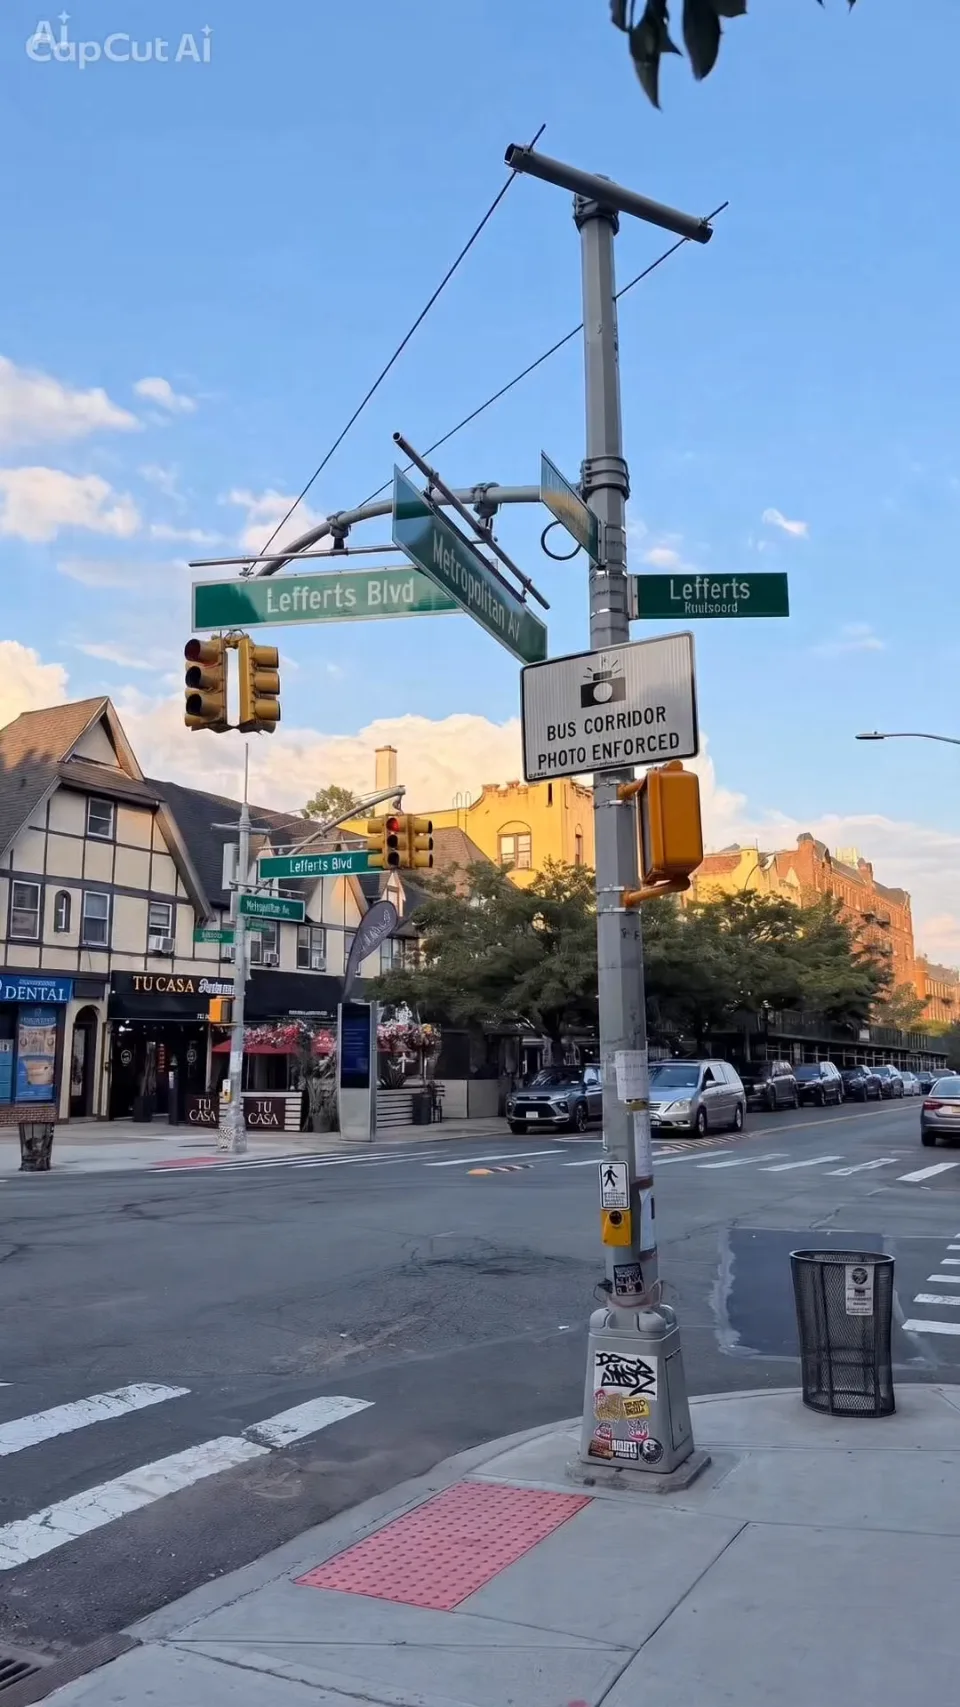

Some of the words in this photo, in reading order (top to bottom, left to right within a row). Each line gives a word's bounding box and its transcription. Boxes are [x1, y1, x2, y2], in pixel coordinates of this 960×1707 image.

[433, 529, 505, 631] Metropolitan
[670, 575, 751, 600] Lefferts
[267, 582, 357, 614] Lefferts
[367, 576, 414, 604] Blvd
[547, 721, 577, 741] BUS
[584, 706, 666, 735] CORRIDOR
[538, 747, 586, 770] PHOTO
[592, 732, 680, 760] ENFORCED
[289, 858, 328, 873] Lefferts
[332, 856, 352, 870] Blvd
[133, 975, 153, 991] TU
[155, 977, 194, 993] CASA
[4, 985, 67, 1001] DENTAL
[196, 1098, 211, 1109] TU
[255, 1101, 272, 1113] TU
[189, 1110, 216, 1122] CASA
[248, 1113, 279, 1125] CASA
